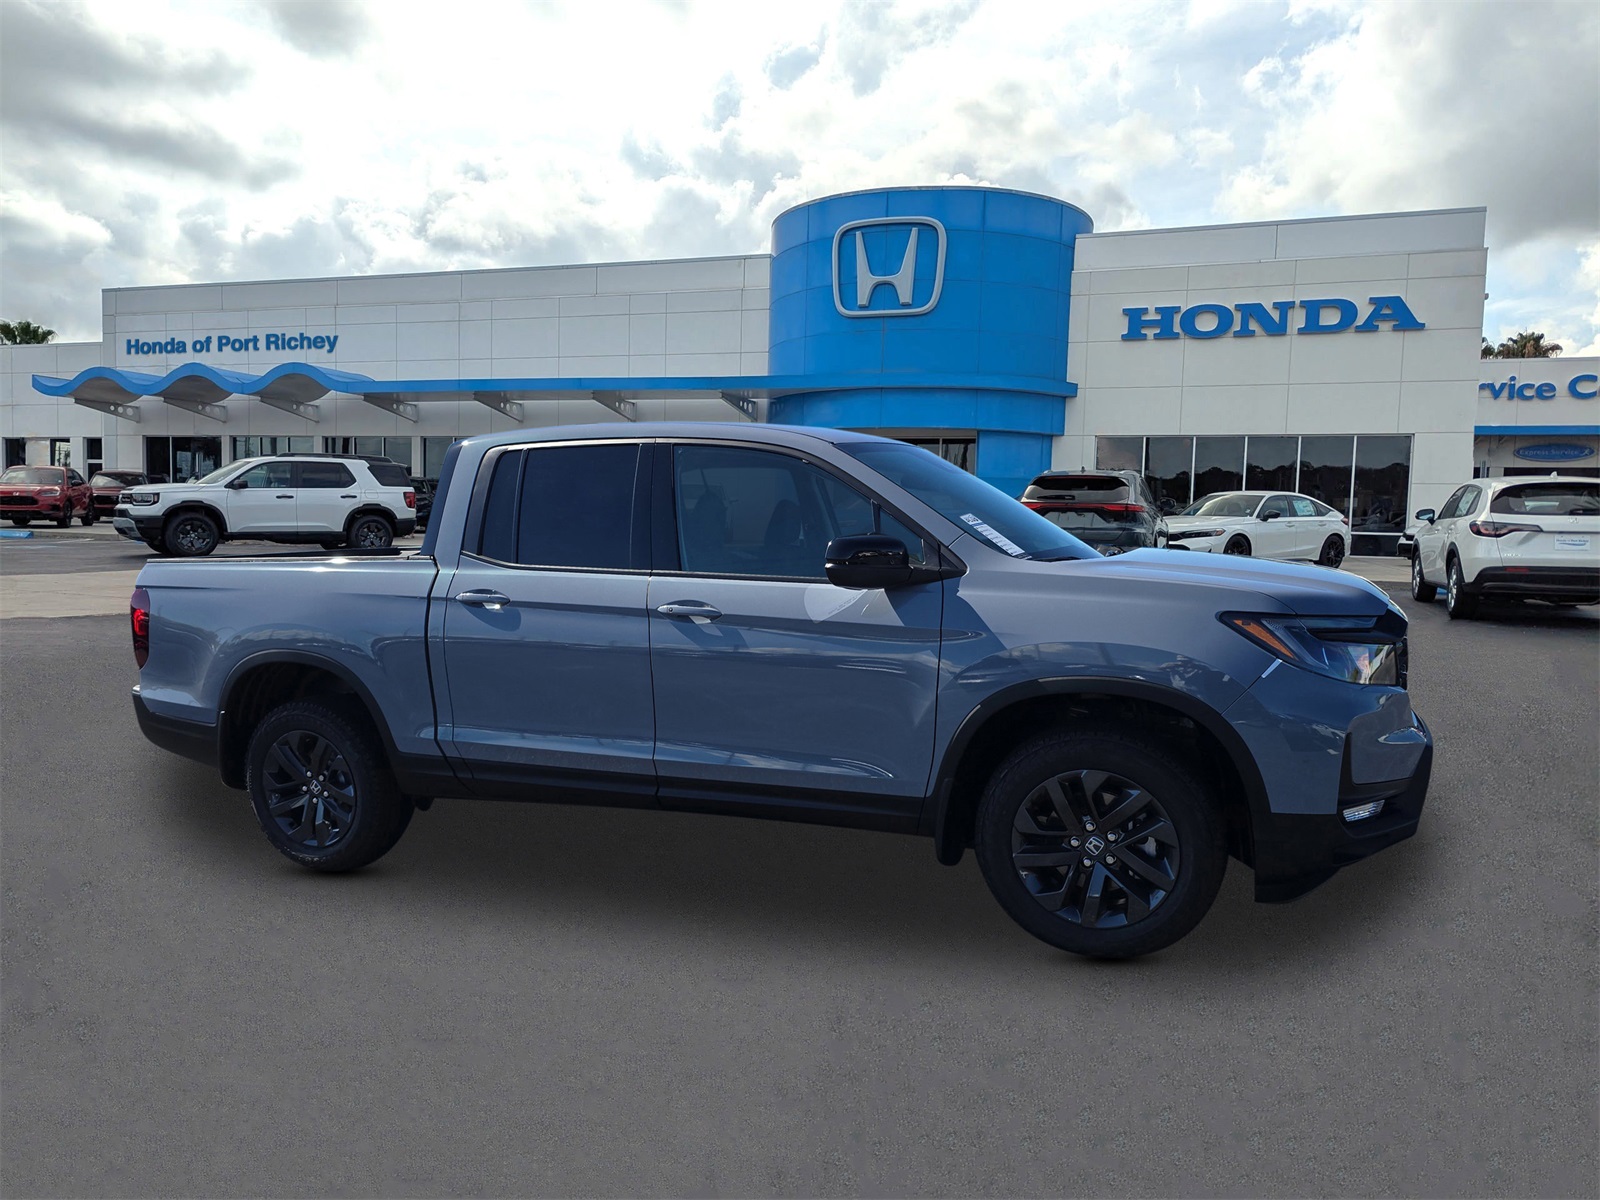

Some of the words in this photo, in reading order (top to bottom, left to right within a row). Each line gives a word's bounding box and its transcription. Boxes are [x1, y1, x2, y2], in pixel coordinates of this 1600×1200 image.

[1121, 295, 1425, 341] HONDA
[126, 337, 187, 355] Honda
[192, 335, 212, 353] of
[217, 334, 259, 352] Port
[265, 332, 339, 353] Richey
[1519, 448, 1549, 457] Express
[1550, 448, 1580, 456] Service
